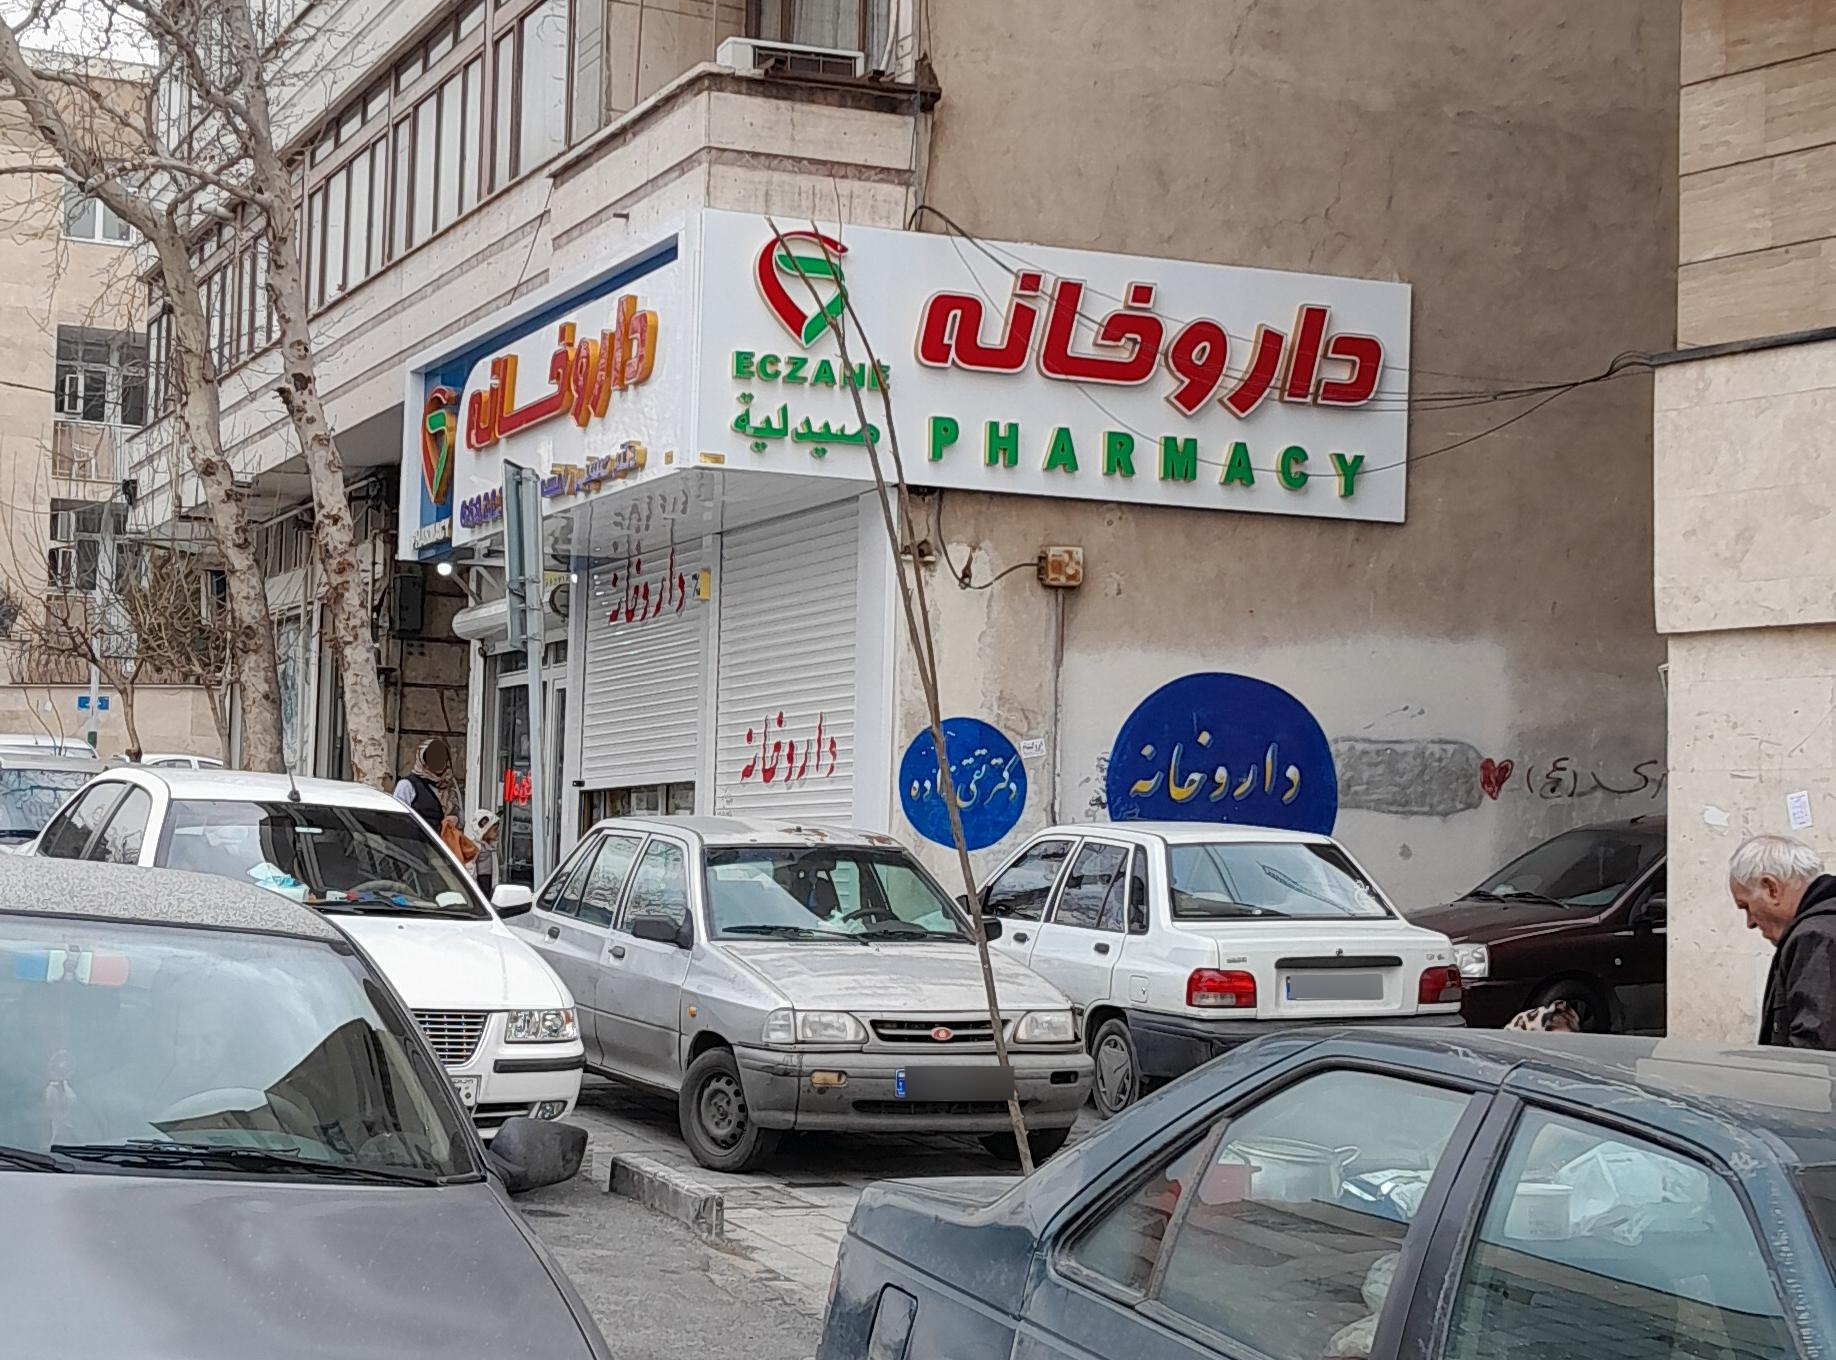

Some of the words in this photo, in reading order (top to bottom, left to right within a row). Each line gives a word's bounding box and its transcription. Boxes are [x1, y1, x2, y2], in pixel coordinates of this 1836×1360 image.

[466, 294, 658, 451] داروخانه
[732, 351, 891, 392] ECZANE
[916, 269, 1384, 418] داروخانه
[928, 416, 1365, 497] PHARMACY
[608, 545, 686, 624] داروخانه
[740, 711, 837, 785] داروخانه
[956, 748, 988, 810] تقی
[984, 754, 1020, 805] دکتر
[1130, 730, 1301, 805] داروخانه
